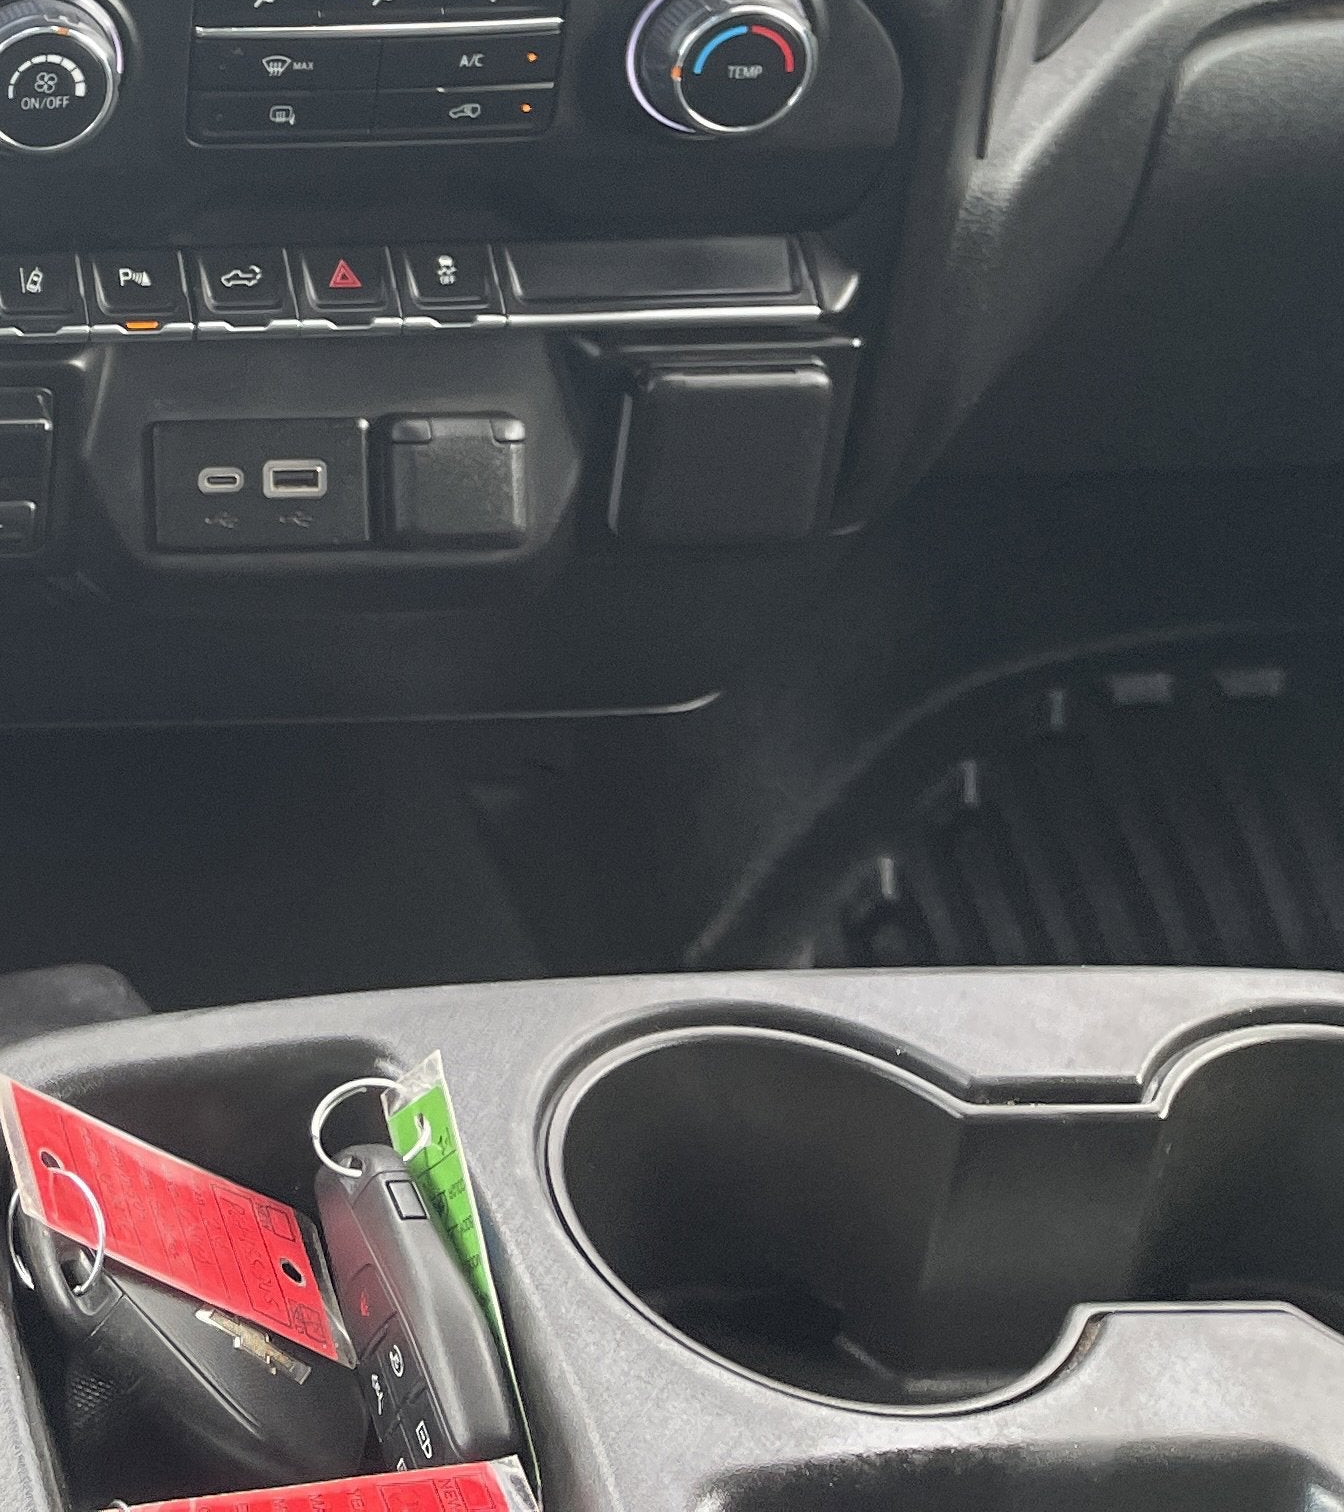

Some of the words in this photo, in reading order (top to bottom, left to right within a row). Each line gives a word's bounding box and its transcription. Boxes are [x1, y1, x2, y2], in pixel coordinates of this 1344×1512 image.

[292, 61, 313, 71] MAX
[459, 53, 485, 68] A/C
[727, 64, 763, 80] TEMP
[20, 95, 70, 111] ON/OFF
